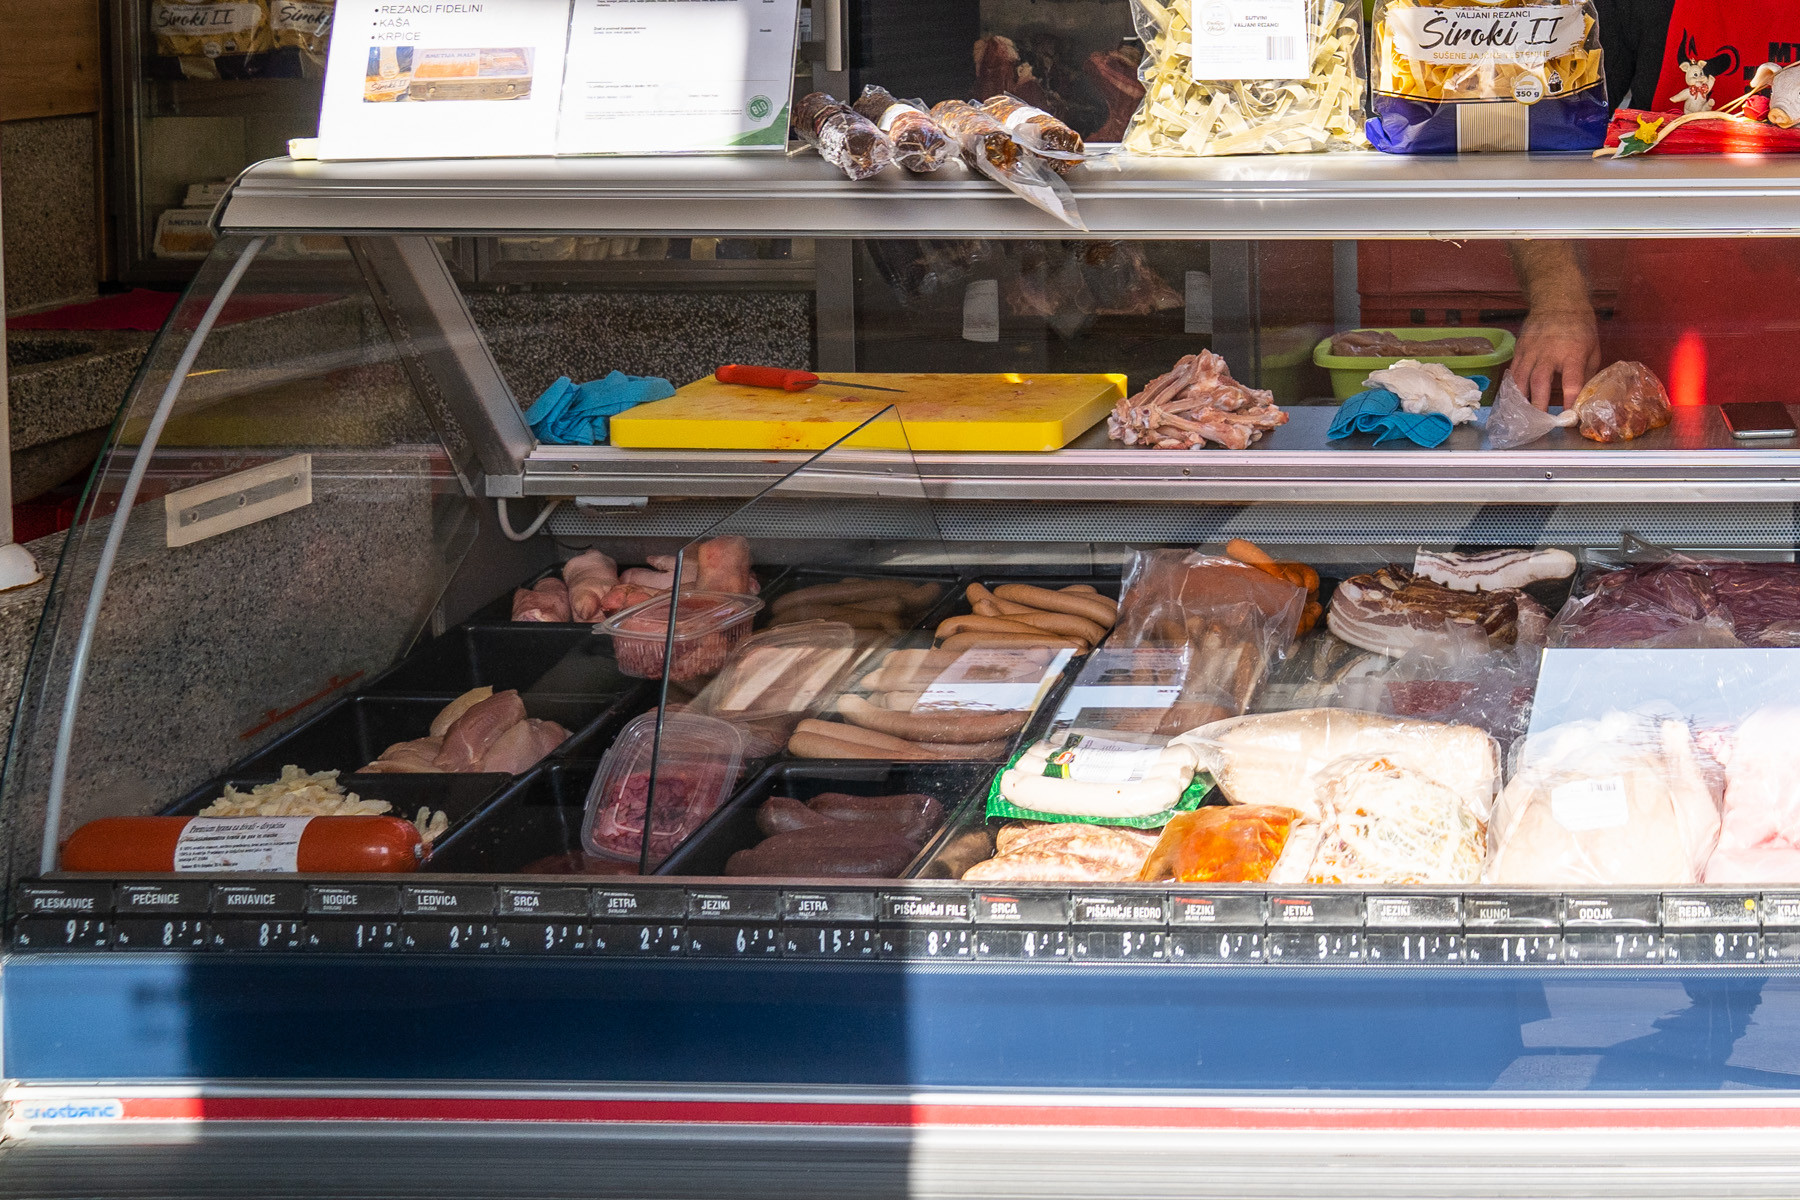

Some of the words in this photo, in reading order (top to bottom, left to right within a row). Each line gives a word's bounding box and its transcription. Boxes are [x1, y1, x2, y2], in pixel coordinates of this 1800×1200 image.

[1455, 11, 1491, 20] VALJANI
[1493, 10, 1531, 19] REZANCI
[1419, 9, 1518, 50] Široki
[1524, 16, 1564, 46] II
[1433, 51, 1467, 60] SUŠENE
[1515, 90, 1532, 98] 350
[1533, 91, 1540, 99] g
[750, 101, 767, 115] BIO
[34, 896, 94, 911] PLESKAVICE
[132, 890, 179, 905] PEČENICE
[227, 893, 275, 905] KRVAVICE
[322, 893, 358, 905] NOGICE
[417, 894, 457, 906] LEDVICA
[513, 895, 539, 907] SRCA
[607, 896, 637, 909] JETRA
[701, 898, 730, 910] JEZIKI
[894, 900, 944, 917] PIŠČANČJI
[945, 903, 966, 917] FILE
[1133, 905, 1161, 919] BEDRO
[1480, 908, 1510, 920] KUNCI
[1579, 907, 1613, 920] ODOJK
